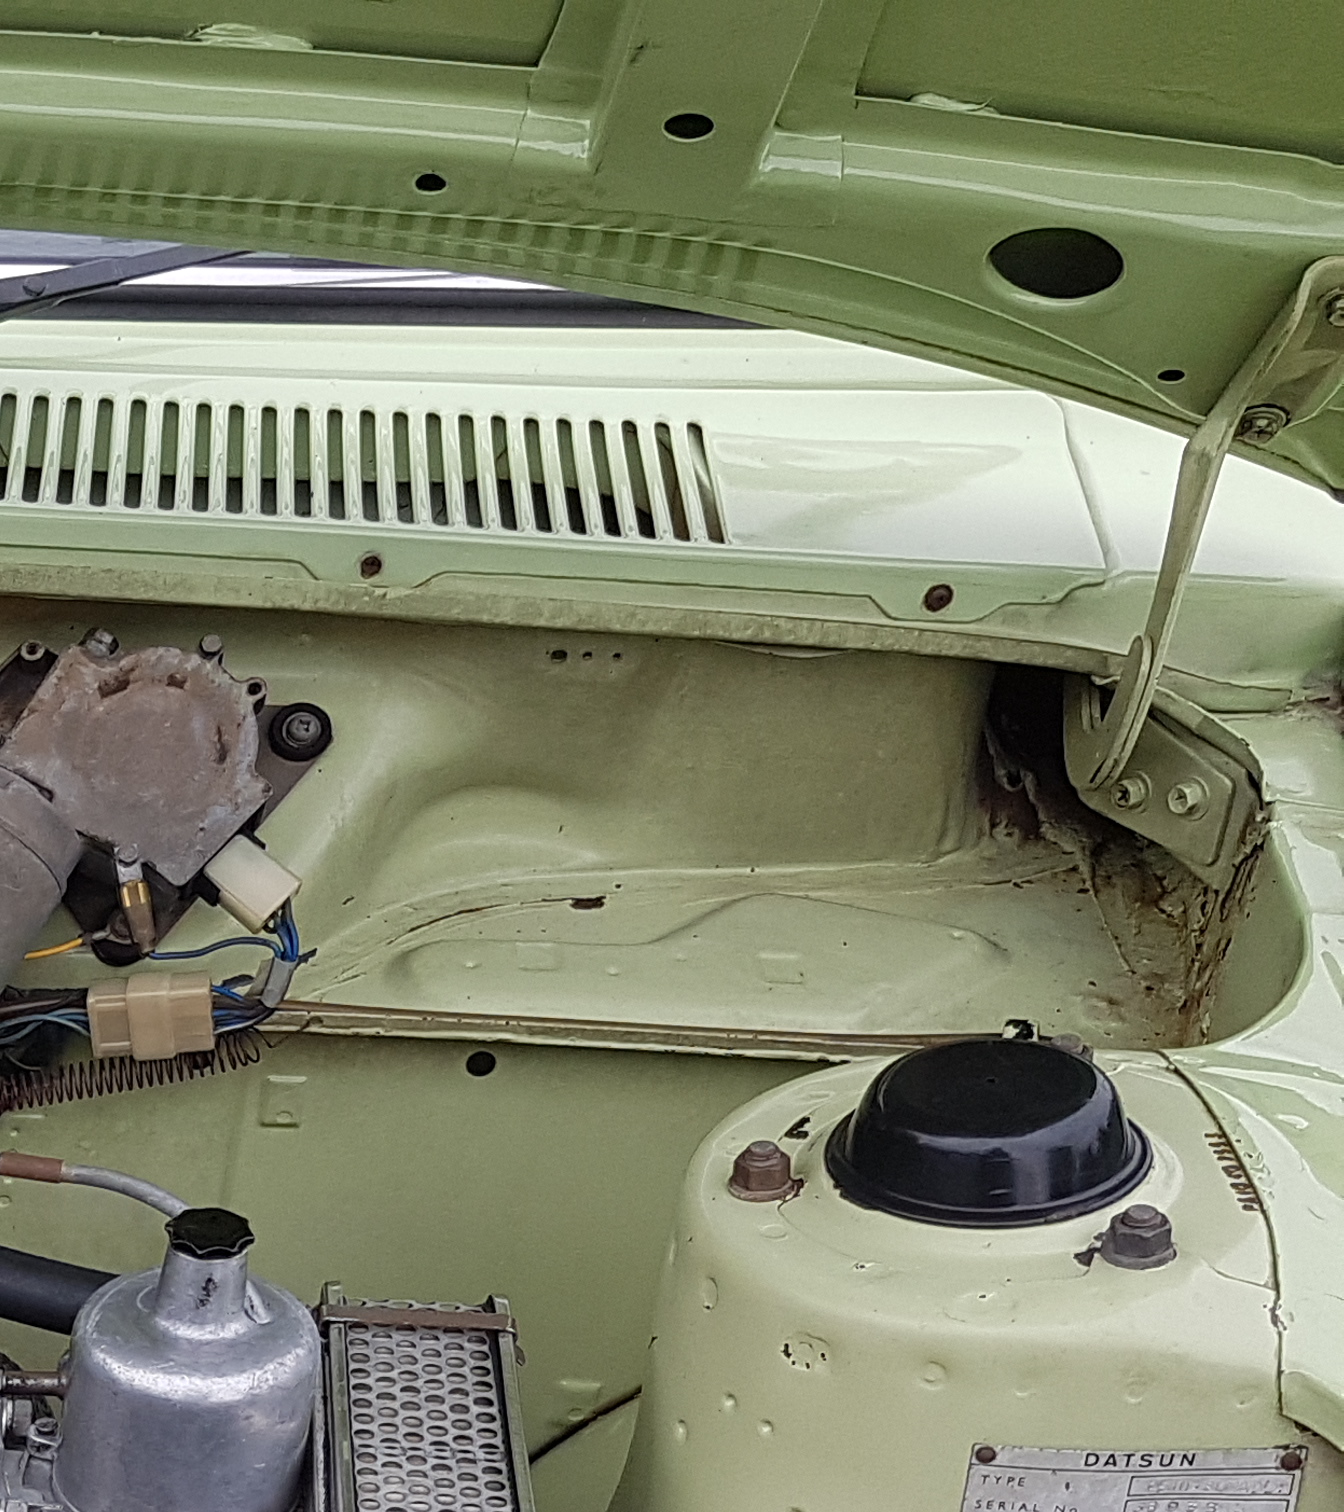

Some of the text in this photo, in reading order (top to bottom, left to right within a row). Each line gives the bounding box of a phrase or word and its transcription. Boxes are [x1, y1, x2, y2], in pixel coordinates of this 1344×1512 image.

[1083, 1452, 1197, 1468] DATSUN
[980, 1475, 1027, 1489] TYPE
[974, 1499, 1042, 1512] SERIAL
